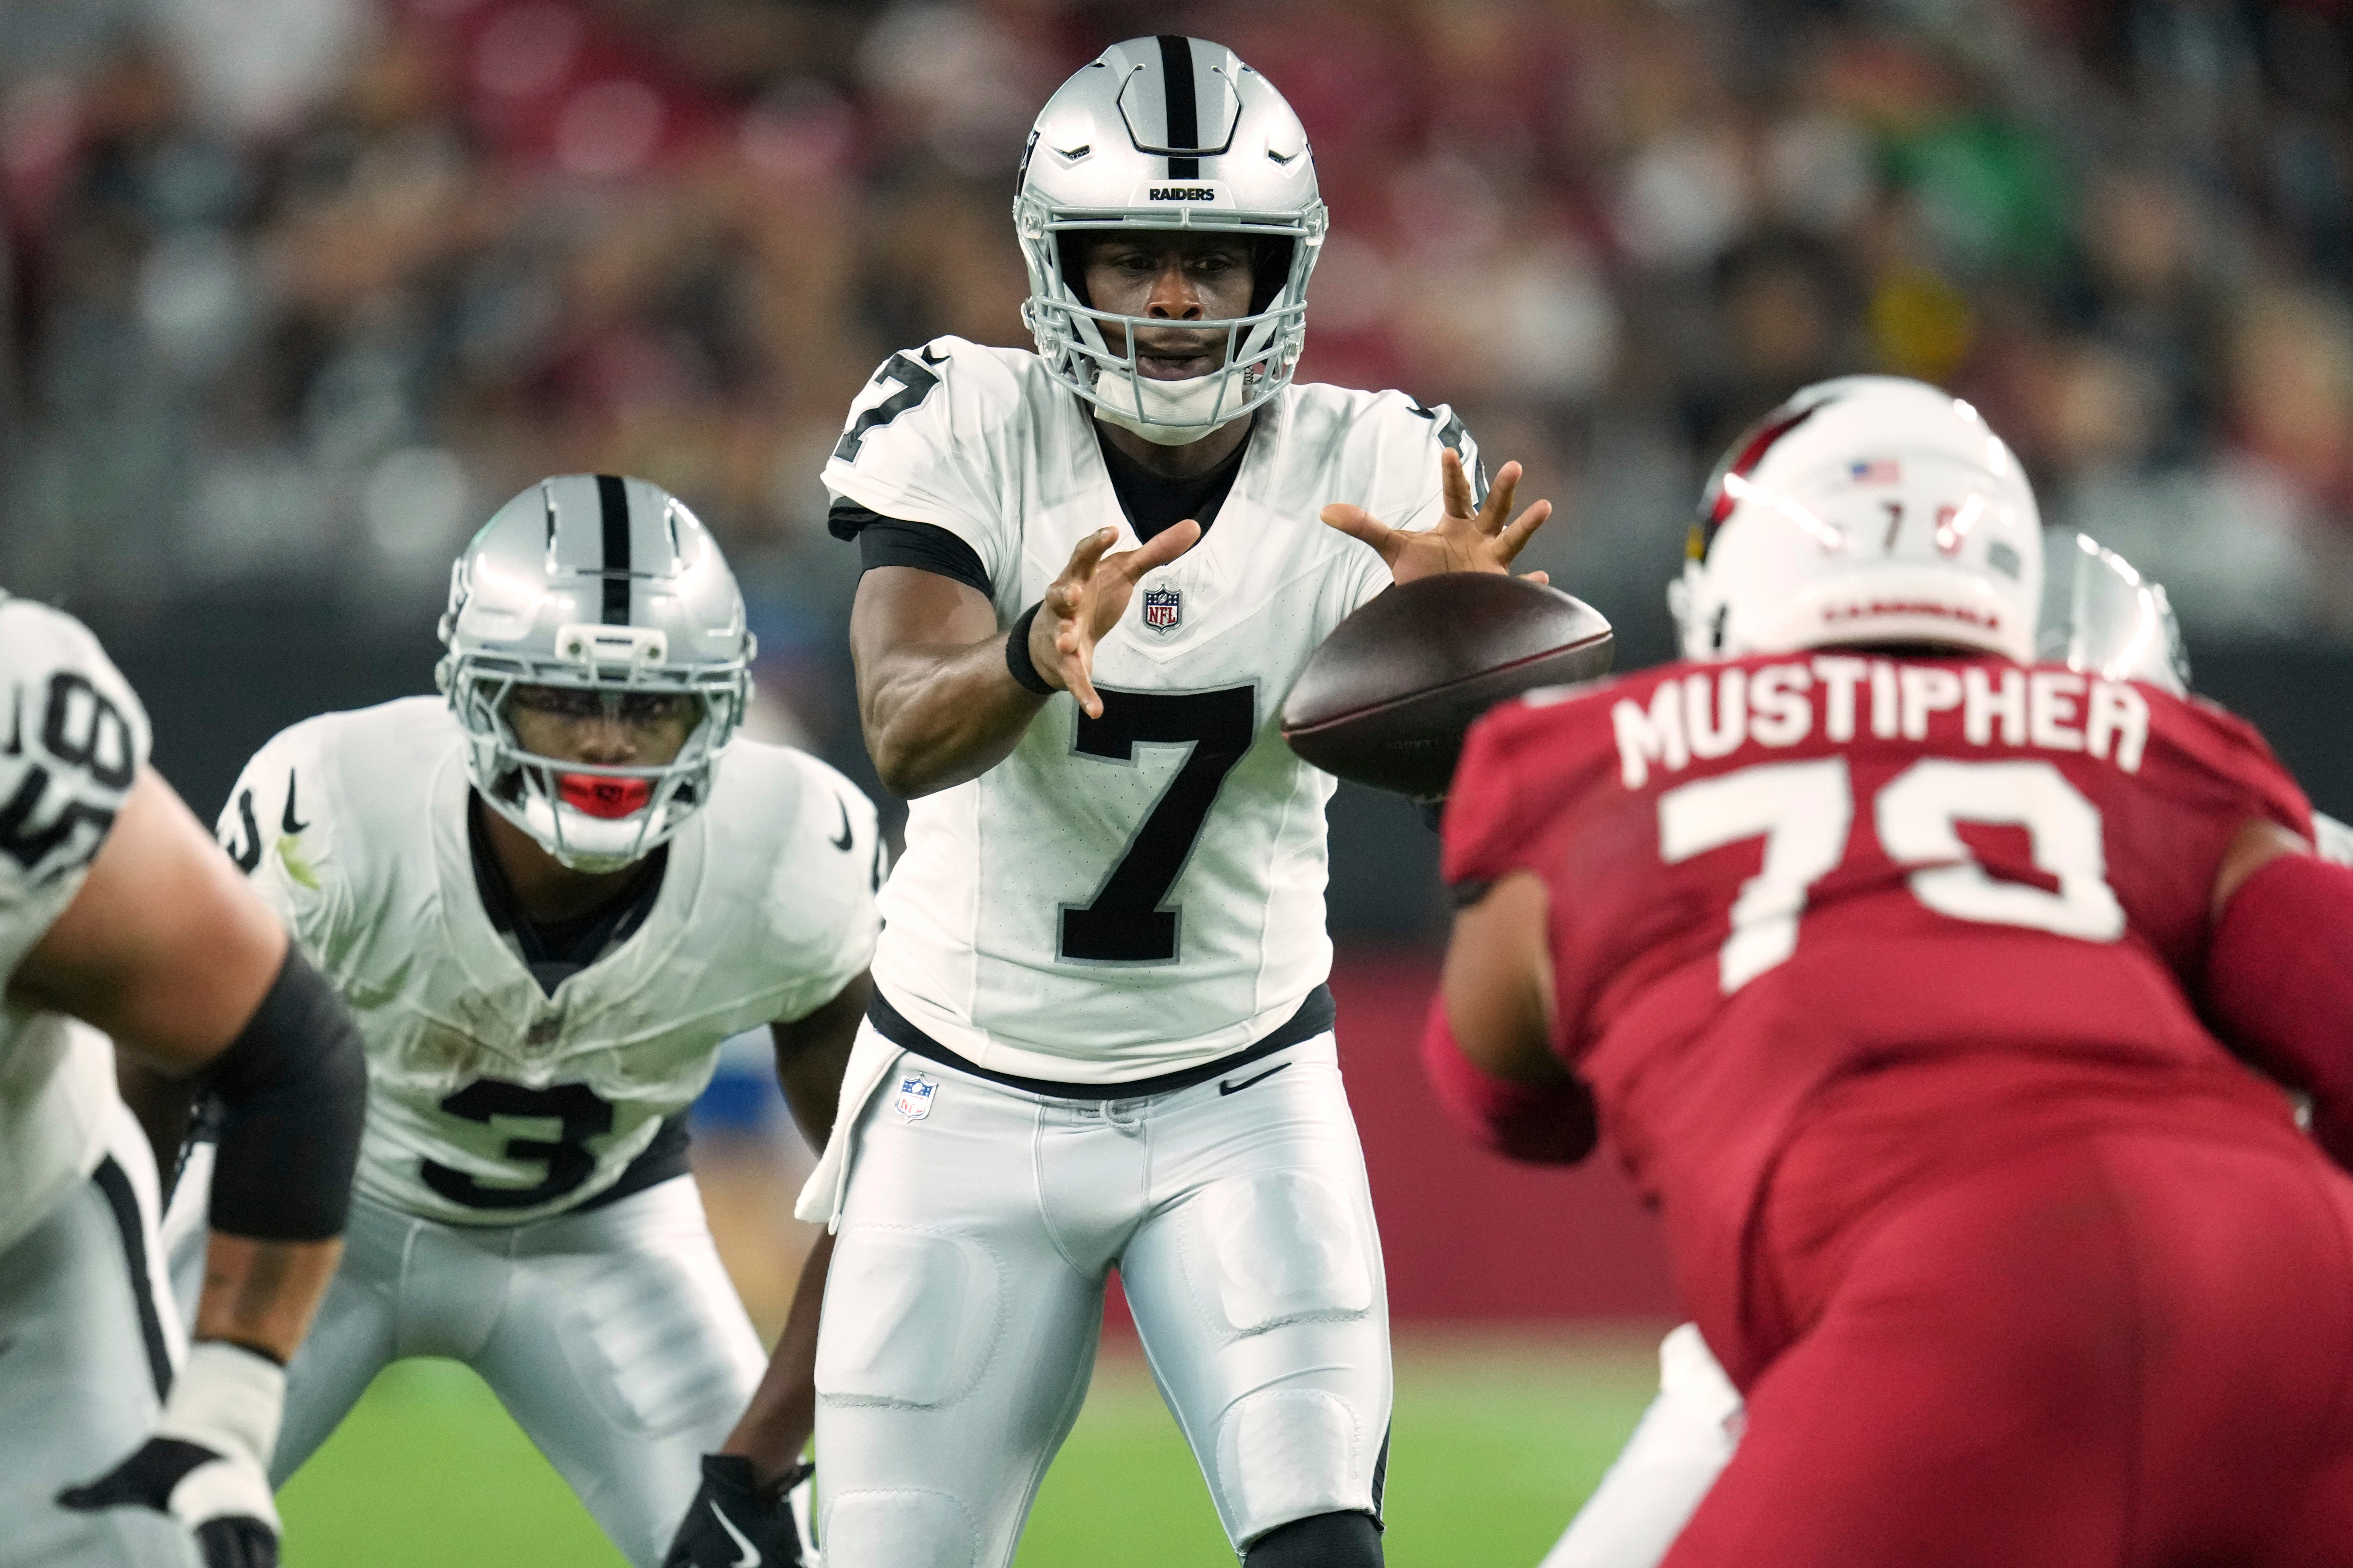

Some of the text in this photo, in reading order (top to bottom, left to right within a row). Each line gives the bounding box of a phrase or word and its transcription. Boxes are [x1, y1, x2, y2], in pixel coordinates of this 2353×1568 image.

[1150, 188, 1214, 201] RAIDERS
[832, 352, 941, 465] 7
[1149, 607, 1175, 625] NFL
[1611, 655, 2150, 790] MUSTIPHER
[1055, 678, 1260, 968] 7
[1658, 754, 2126, 995] 79
[420, 1077, 612, 1209] 3
